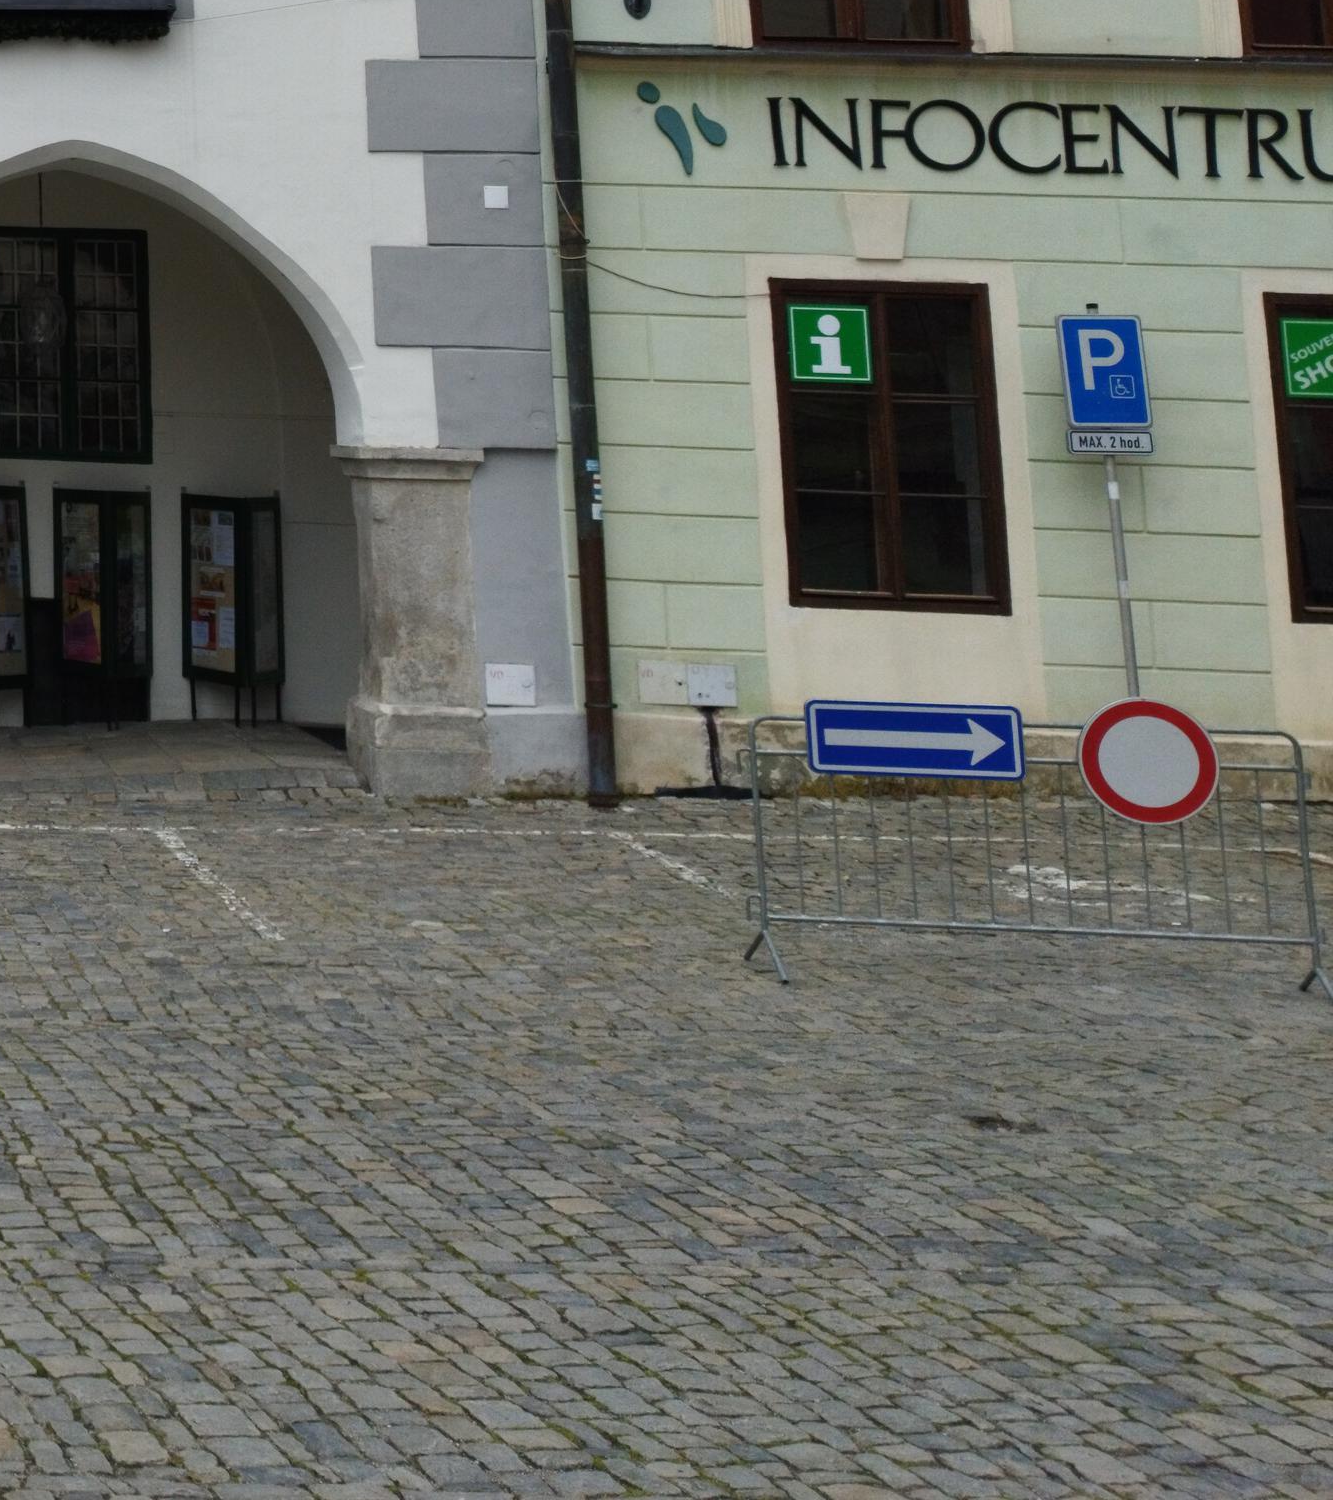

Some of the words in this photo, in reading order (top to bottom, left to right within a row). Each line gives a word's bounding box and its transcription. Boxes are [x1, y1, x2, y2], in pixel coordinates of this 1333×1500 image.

[1077, 329, 1125, 390] P
[1079, 436, 1107, 449] MAX.
[1110, 437, 1117, 449] 2
[1120, 436, 1145, 449] hod.
